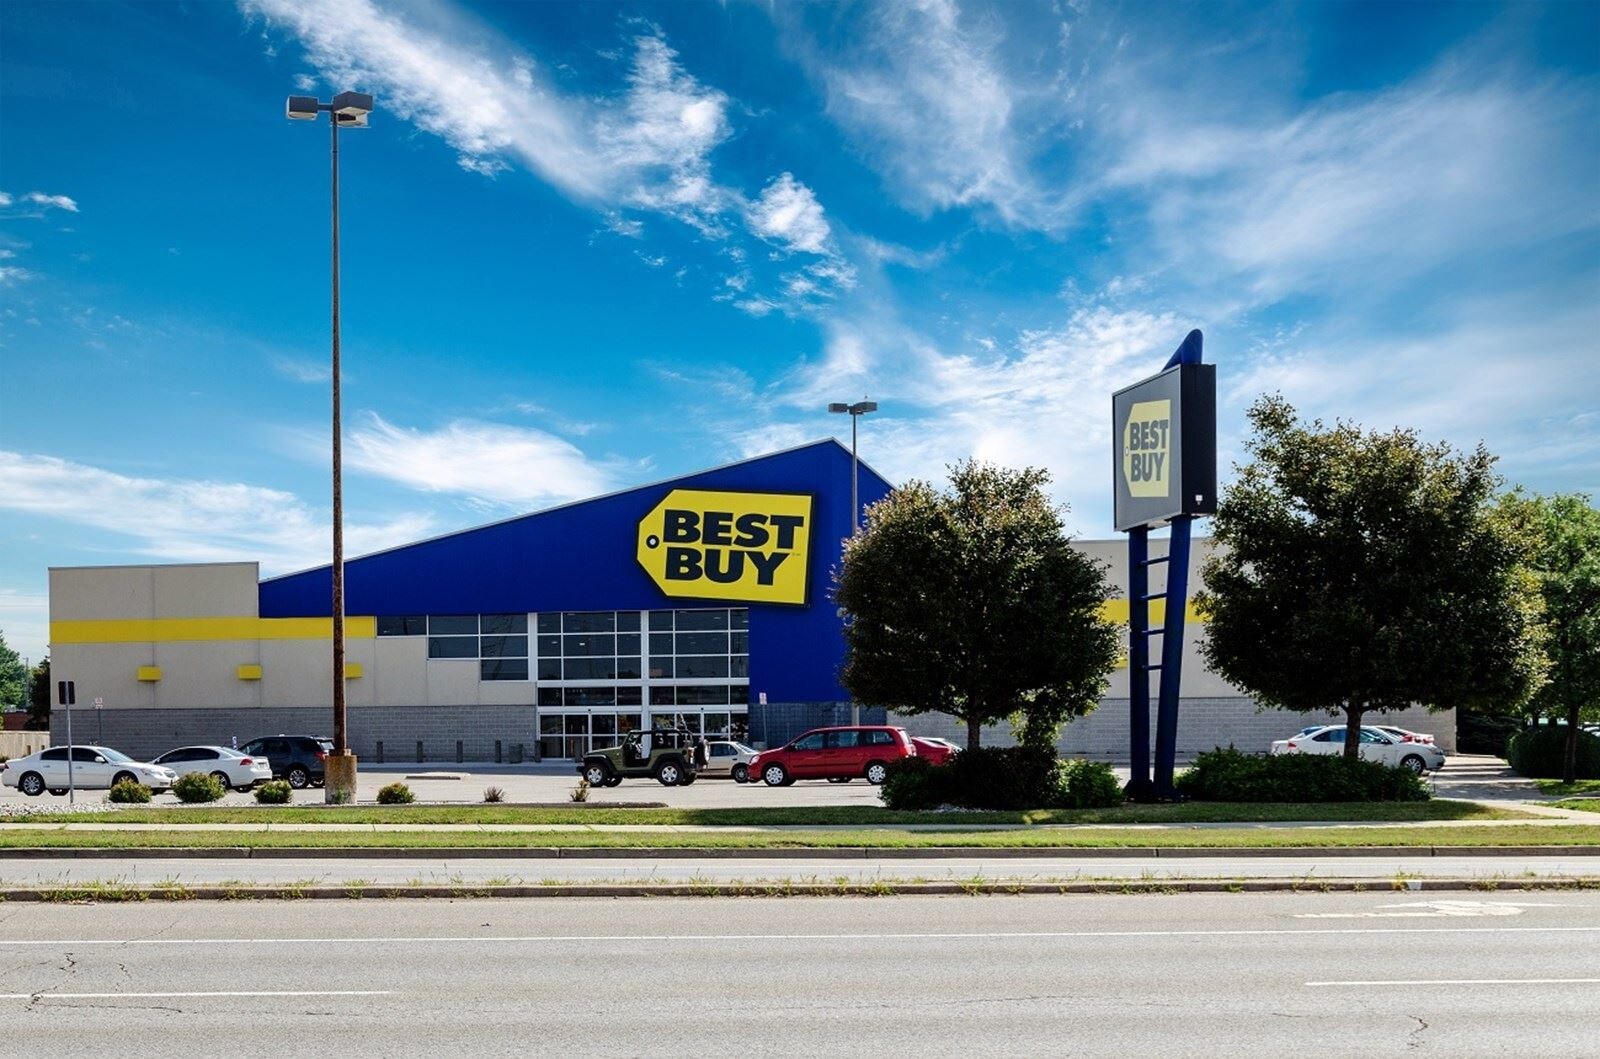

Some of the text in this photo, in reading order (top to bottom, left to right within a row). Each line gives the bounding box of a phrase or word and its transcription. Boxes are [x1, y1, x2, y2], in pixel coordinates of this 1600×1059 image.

[1130, 420, 1168, 450] BEST
[1131, 453, 1165, 481] BUY
[663, 509, 804, 549] BEST
[665, 547, 790, 585] BUY
